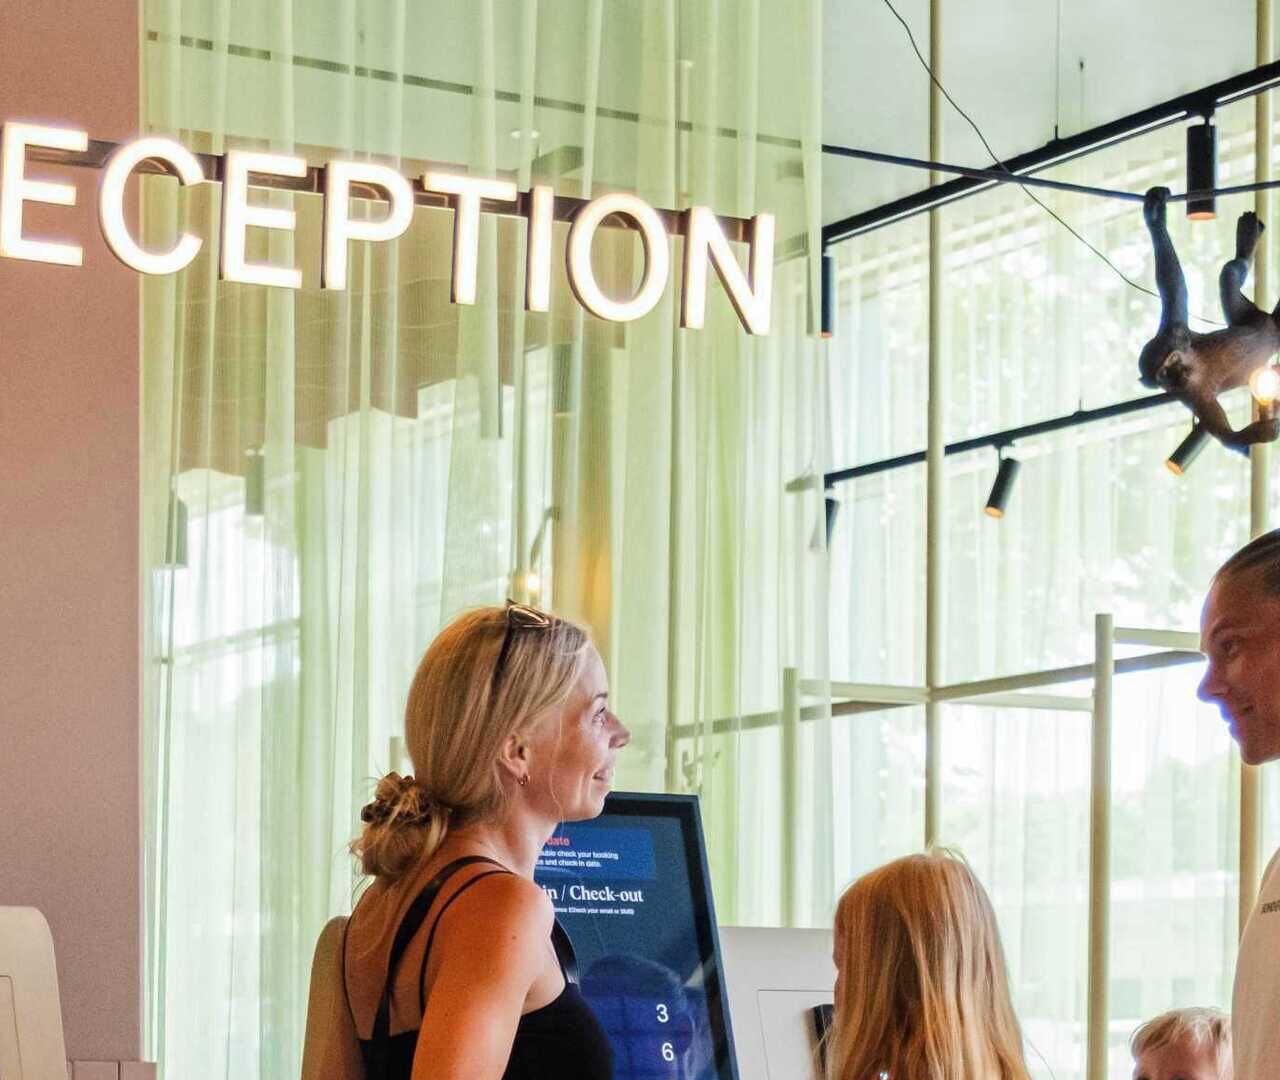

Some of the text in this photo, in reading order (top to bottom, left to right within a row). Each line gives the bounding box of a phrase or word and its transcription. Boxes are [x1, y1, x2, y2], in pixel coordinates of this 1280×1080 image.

[569, 885, 644, 902] Check-out
[656, 1003, 670, 1023] 3
[661, 1042, 675, 1062] 6
